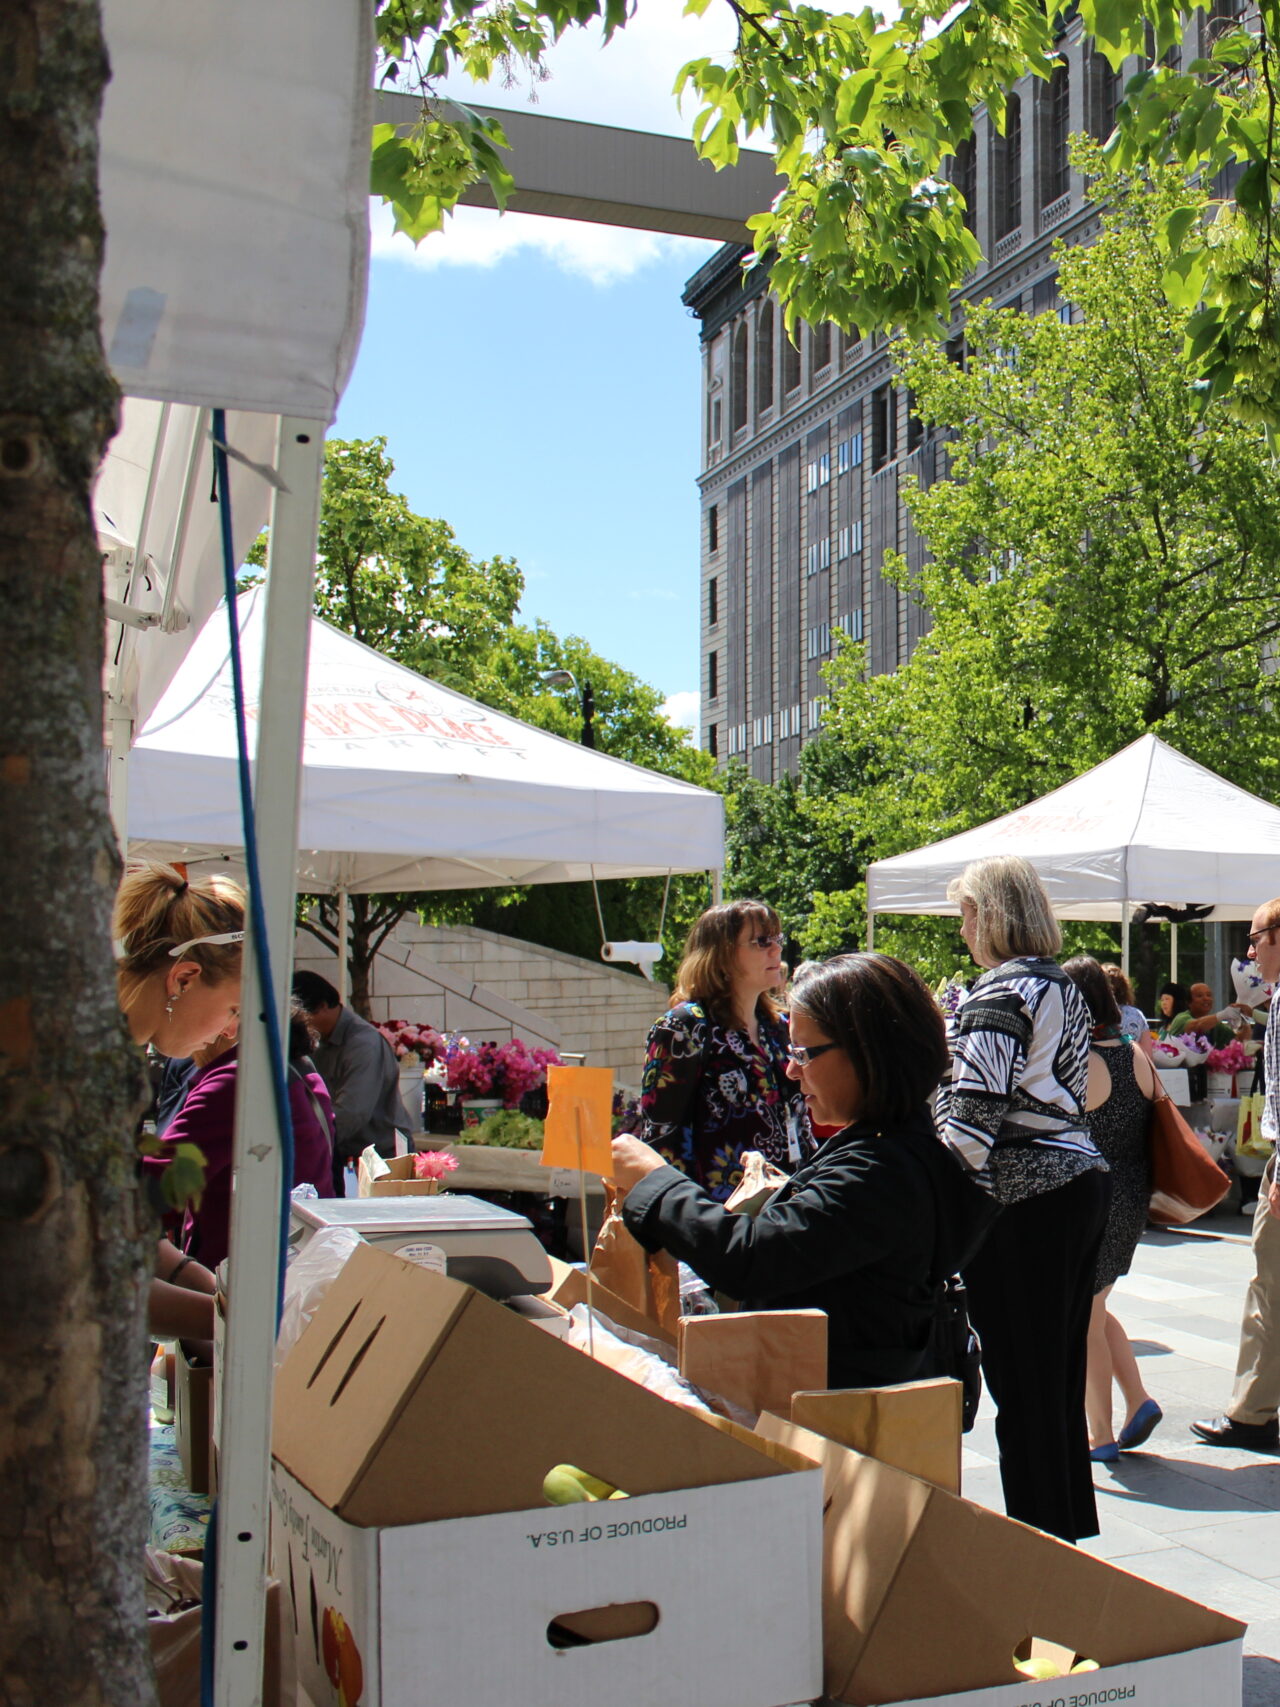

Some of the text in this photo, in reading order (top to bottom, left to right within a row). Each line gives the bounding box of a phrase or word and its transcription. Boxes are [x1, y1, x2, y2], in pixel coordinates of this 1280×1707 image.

[388, 705, 513, 747] PLACE
[305, 739, 527, 760] ARKET
[526, 1514, 687, 1548] PRODUCE OF U.S.A.
[1069, 1684, 1136, 1706] PRODUCE
